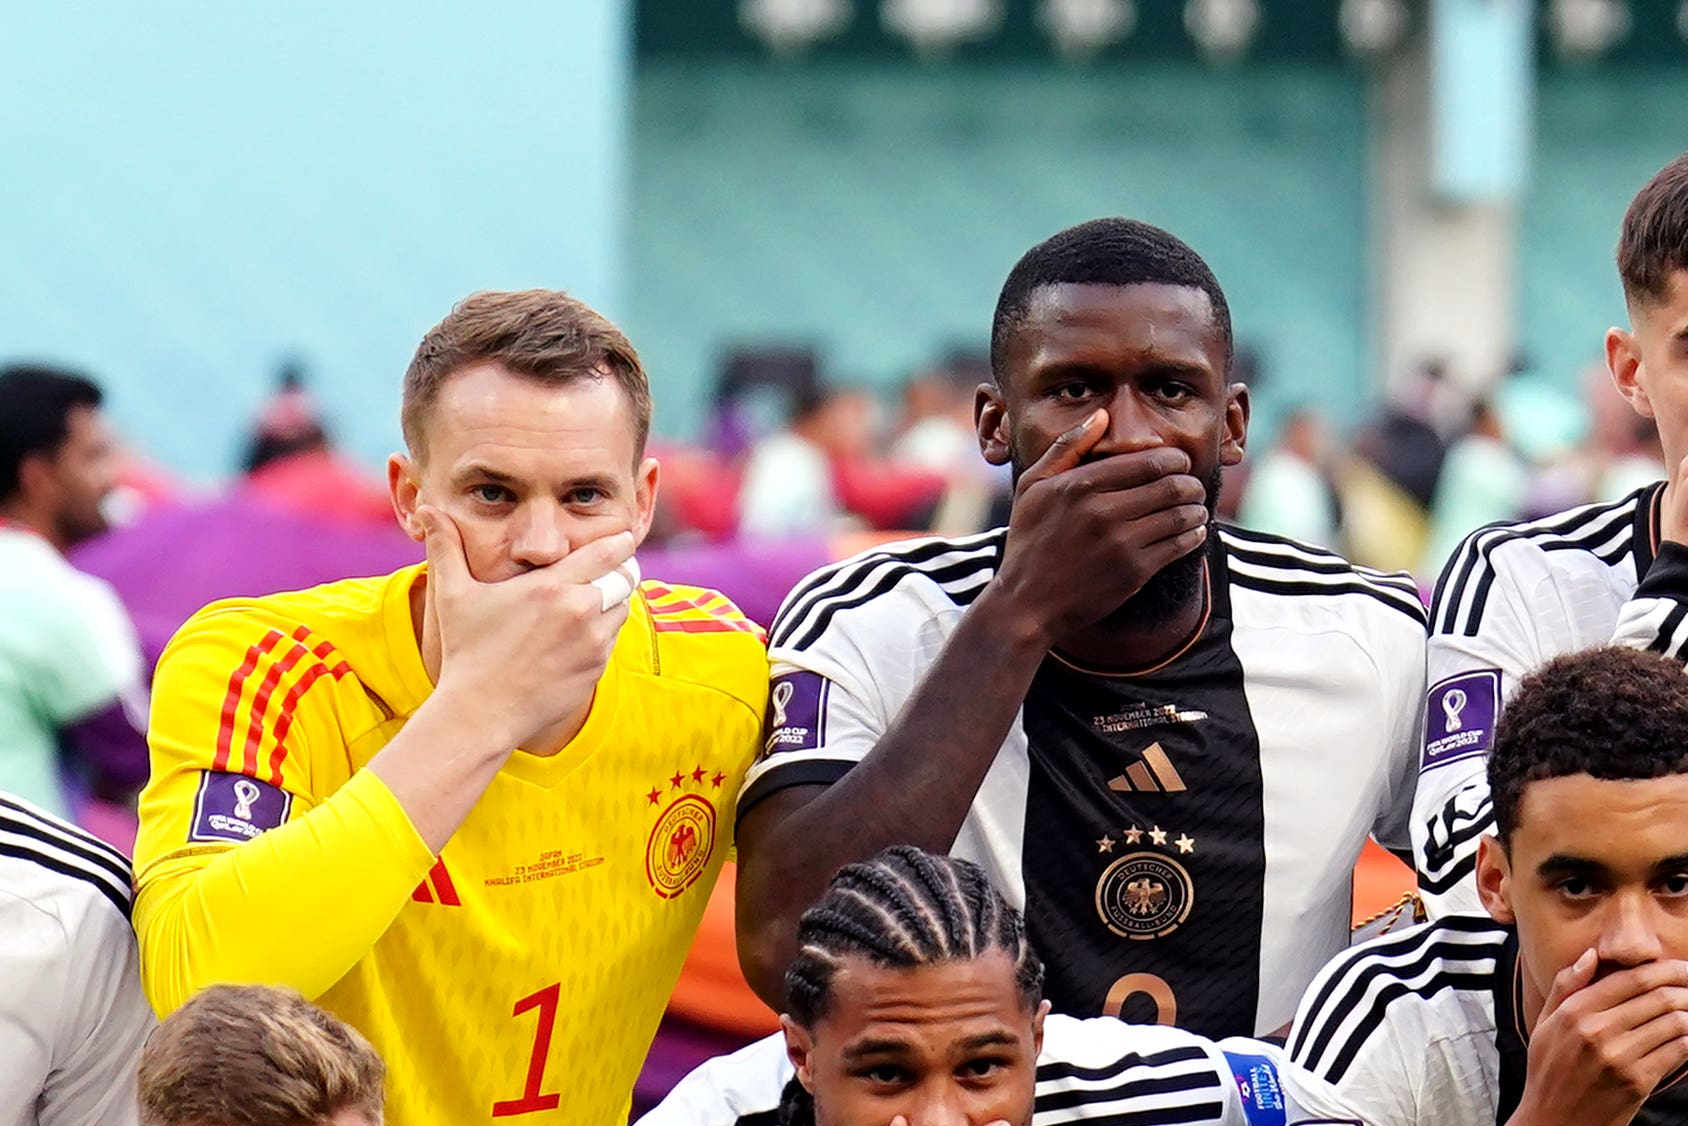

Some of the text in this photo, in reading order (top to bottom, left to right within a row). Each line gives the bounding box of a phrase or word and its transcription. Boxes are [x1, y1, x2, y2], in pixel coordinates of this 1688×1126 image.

[1093, 704, 1176, 726] 23 NOVEMBER 2022
[1440, 732, 1467, 746] WORLD
[1467, 730, 1484, 740] CUP
[484, 876, 521, 887] KHALIFA
[523, 864, 578, 884] INTERNATIONAL
[515, 866, 526, 875] 23
[528, 857, 565, 874] NOVEMBER
[1117, 863, 1174, 881] DEUTSCHER
[491, 981, 562, 1118] 1
